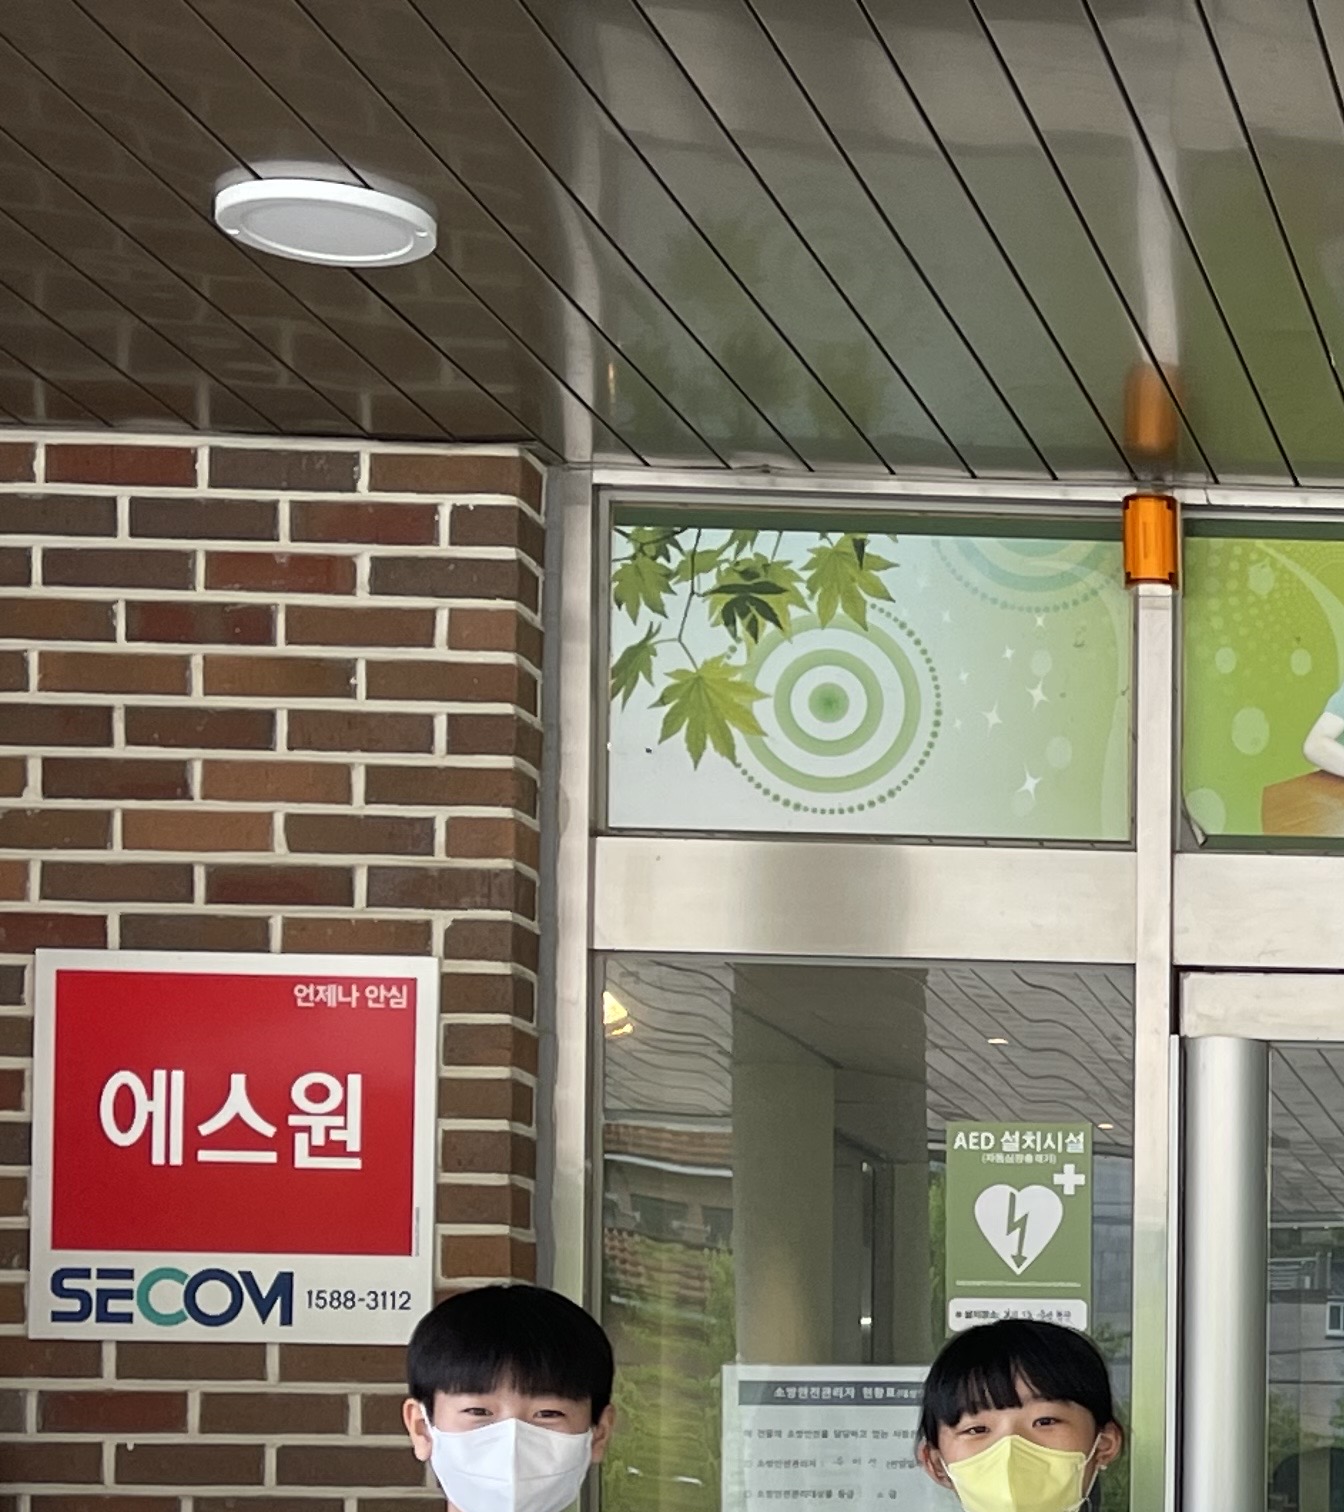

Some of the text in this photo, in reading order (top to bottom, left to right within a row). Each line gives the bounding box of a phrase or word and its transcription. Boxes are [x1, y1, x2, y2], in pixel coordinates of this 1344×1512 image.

[293, 983, 408, 1009] 언제나 안심
[98, 1068, 363, 1170] 에스원
[953, 1131, 1085, 1153] AED 설치시설
[50, 1266, 411, 1328] SECOM 1588-3112
